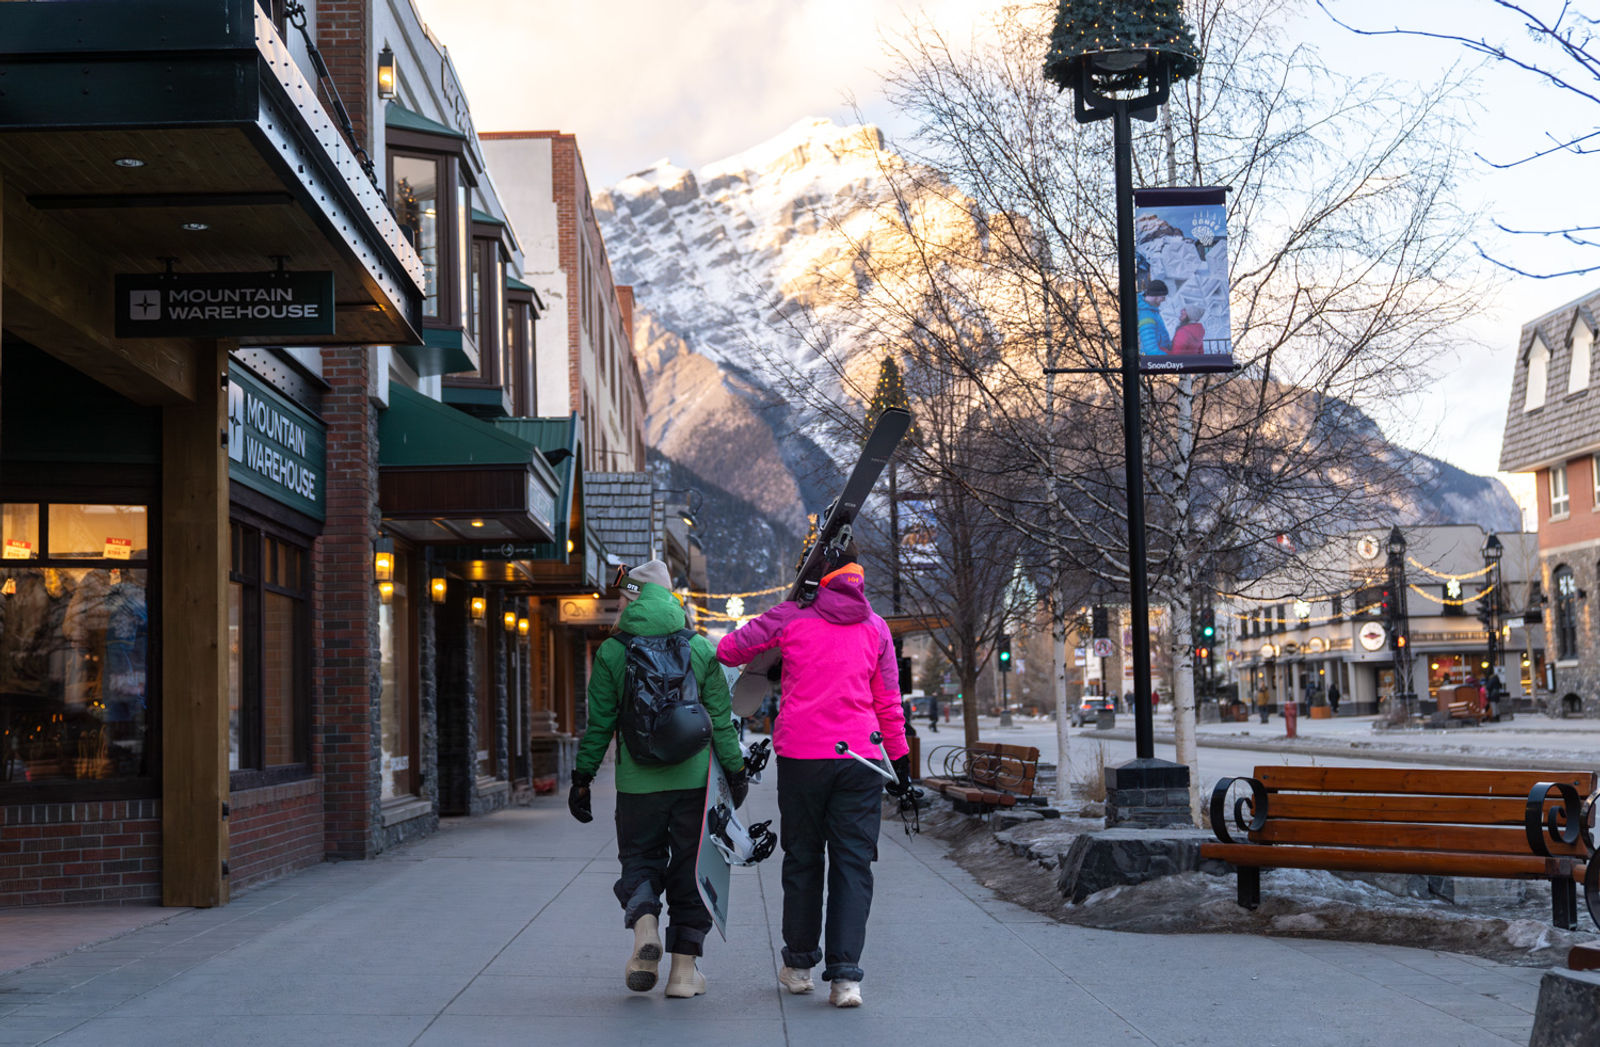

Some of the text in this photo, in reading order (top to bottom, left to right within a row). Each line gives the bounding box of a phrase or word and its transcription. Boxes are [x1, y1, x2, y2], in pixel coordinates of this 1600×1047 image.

[168, 288, 293, 302] MOUNTAIN
[168, 304, 319, 320] WAREHOUSE
[1147, 361, 1184, 371] SnowDays
[247, 393, 306, 458] MOUNTAIN
[246, 434, 316, 501] WAREHOUSE
